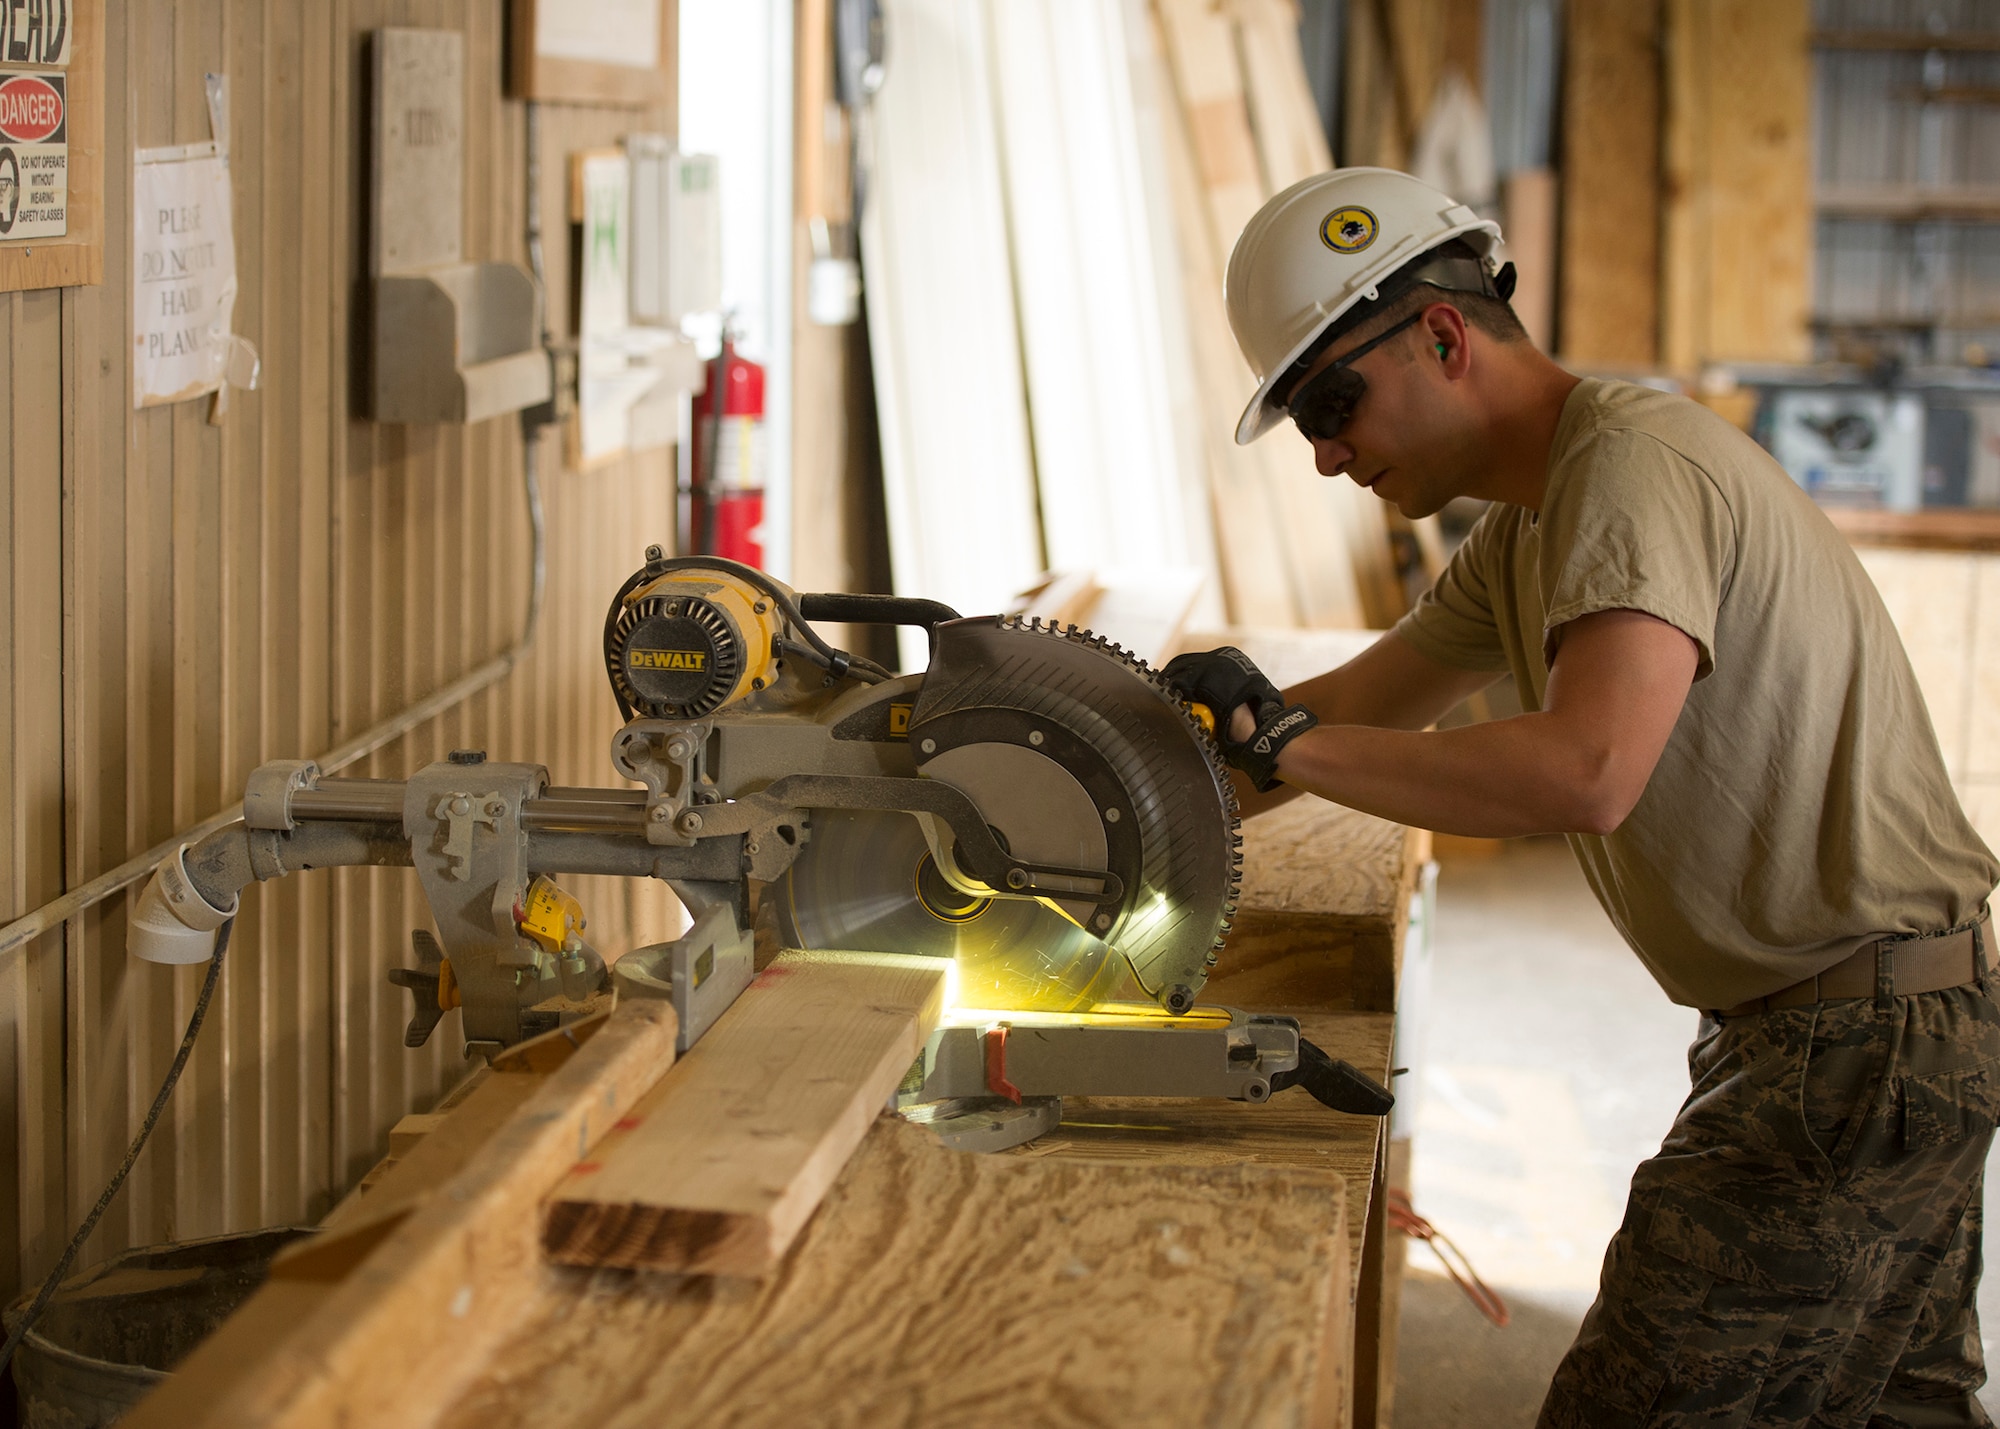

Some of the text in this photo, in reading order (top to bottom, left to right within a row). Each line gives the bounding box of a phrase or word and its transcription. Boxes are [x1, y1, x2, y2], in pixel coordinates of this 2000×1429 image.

[0, 93, 57, 125] DANGER
[21, 155, 65, 169] DO NOT OPERATE
[31, 173, 55, 186] WITHOUT
[31, 192, 55, 204] WEARING
[19, 208, 64, 222] SAFETY GLASSES
[142, 250, 165, 277] DO
